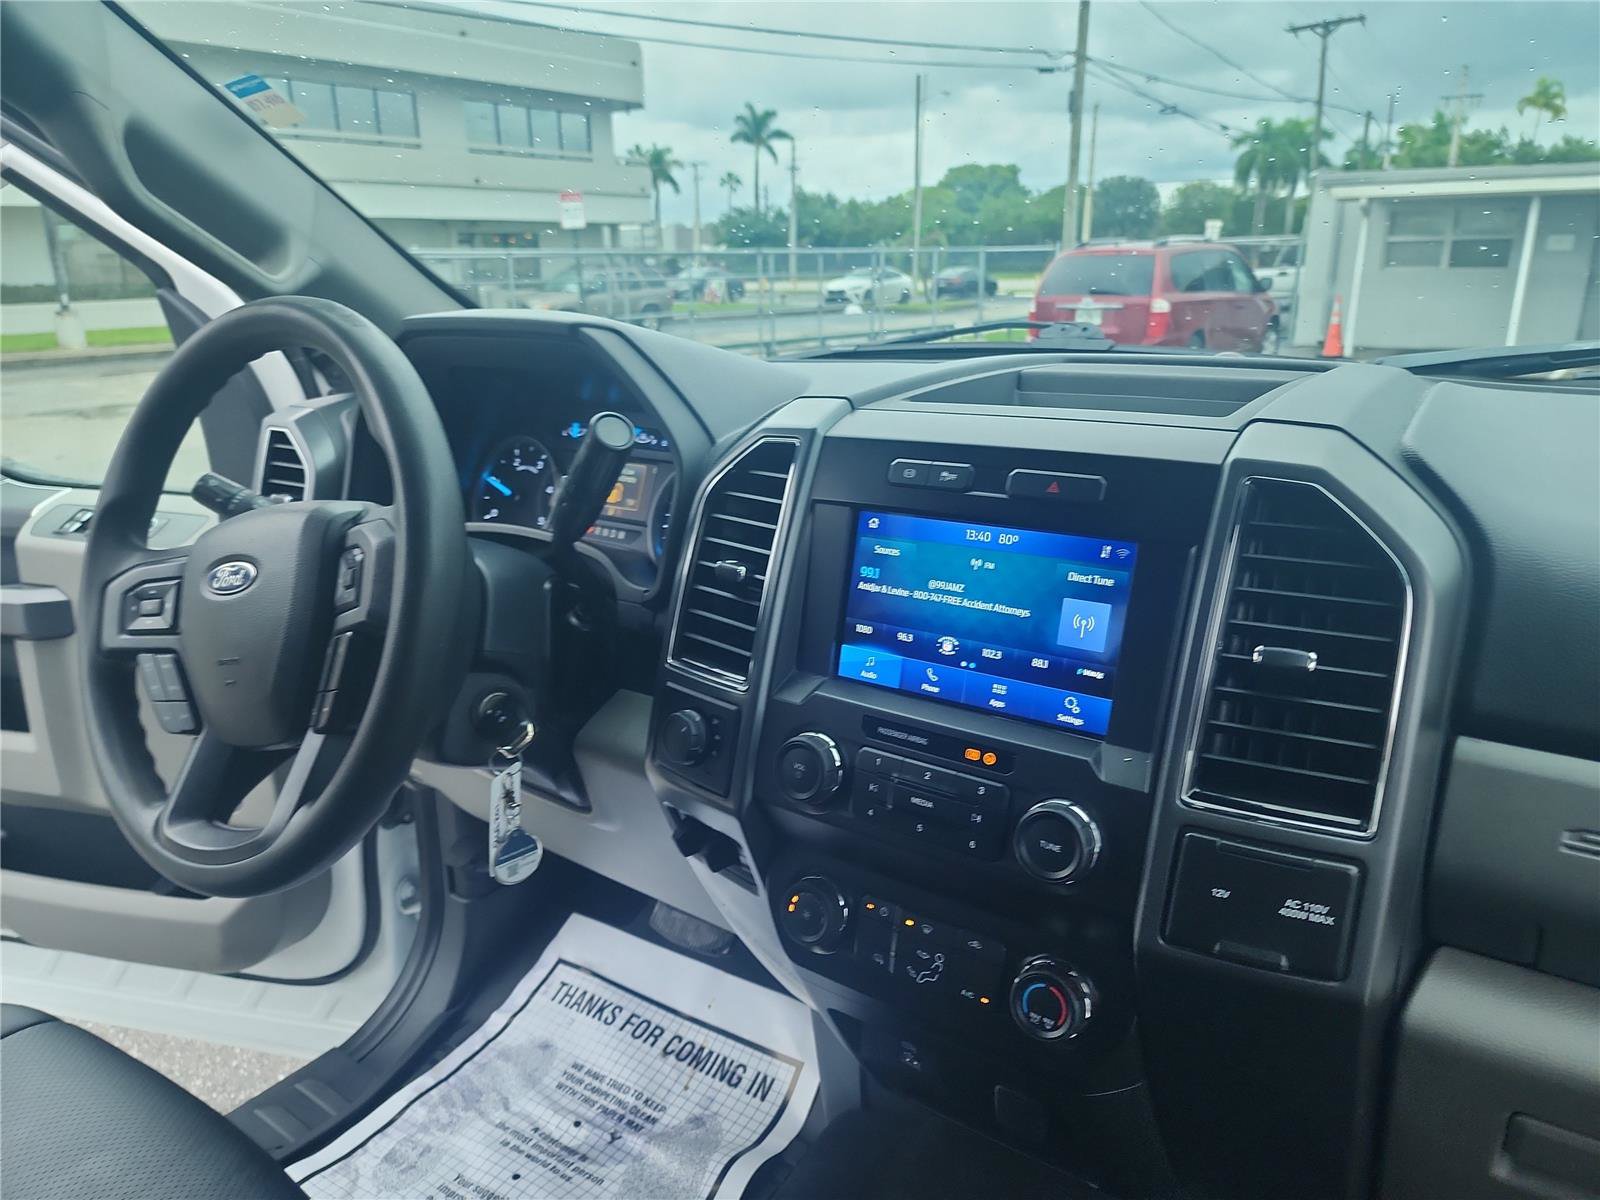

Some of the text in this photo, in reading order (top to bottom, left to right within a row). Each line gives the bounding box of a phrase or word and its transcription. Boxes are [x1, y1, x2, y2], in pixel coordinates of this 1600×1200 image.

[965, 529, 992, 543] 13:40
[873, 544, 901, 557] Sources
[213, 565, 248, 588] Ford
[1067, 571, 1115, 587] Direct Tune
[928, 578, 966, 593] @99JAMZ
[857, 581, 881, 593] Anidjar
[881, 584, 888, 593] &
[887, 586, 910, 598] Levine
[912, 590, 963, 606] 800-747-FREE
[962, 598, 994, 613] Accident
[994, 602, 1032, 618] Attorneys
[860, 670, 878, 680] Audio
[920, 683, 941, 693] Phone
[988, 698, 1007, 709] Apps
[1056, 713, 1085, 726] Settings
[1211, 887, 1231, 899] 12V
[1283, 898, 1331, 915] AC 110V
[1308, 913, 1336, 926] MAX
[551, 981, 775, 1102] THANKS FOR COMING IN
[571, 1062, 667, 1113] WE HAVE TRIED TO KEEP
[562, 1069, 660, 1126] YOUR CARPETING CLEAN
[556, 1081, 645, 1133] WITH THIS PAPER MAT
[509, 1129, 533, 1145] most
[530, 1141, 575, 1169] important
[571, 1166, 605, 1186] person
[525, 1152, 552, 1169] world
[549, 1165, 561, 1175] to
[453, 1173, 474, 1190] Your
